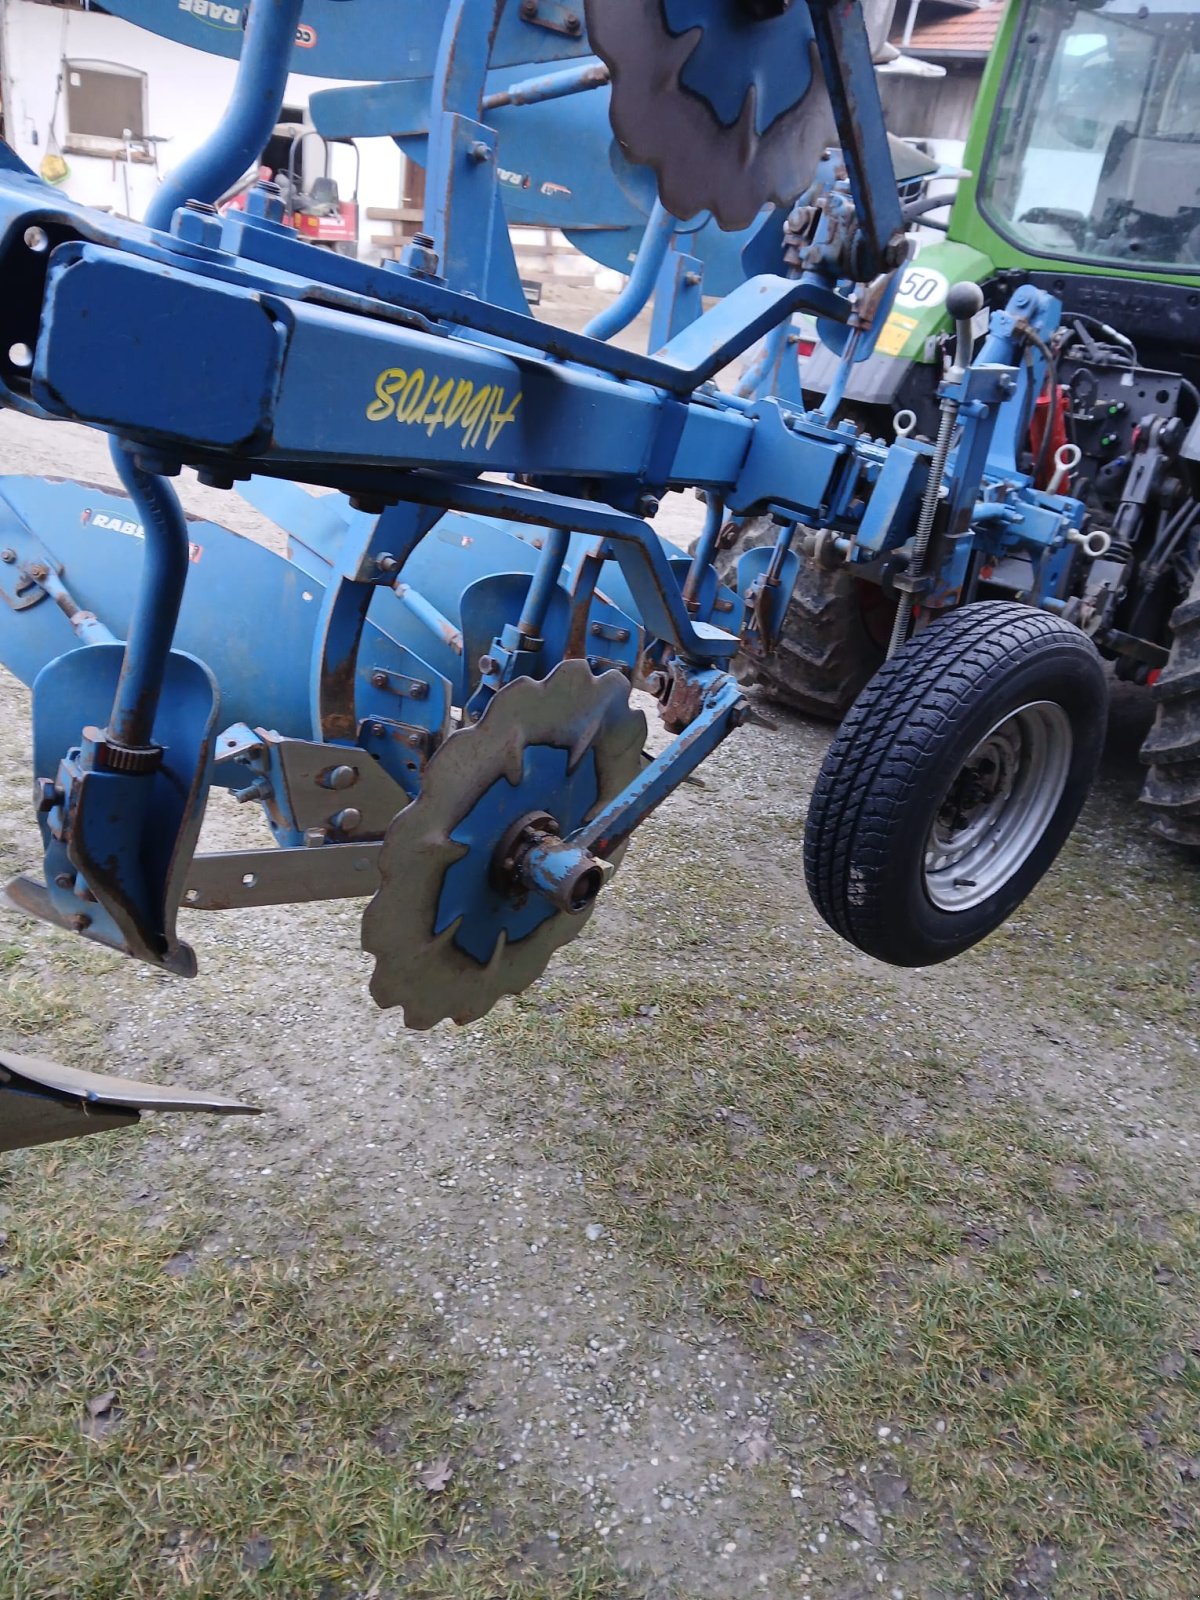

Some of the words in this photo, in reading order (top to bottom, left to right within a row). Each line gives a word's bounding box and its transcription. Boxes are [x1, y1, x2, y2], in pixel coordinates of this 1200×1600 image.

[496, 167, 522, 185] RA
[899, 272, 938, 302] 50
[366, 367, 523, 450] Albatros
